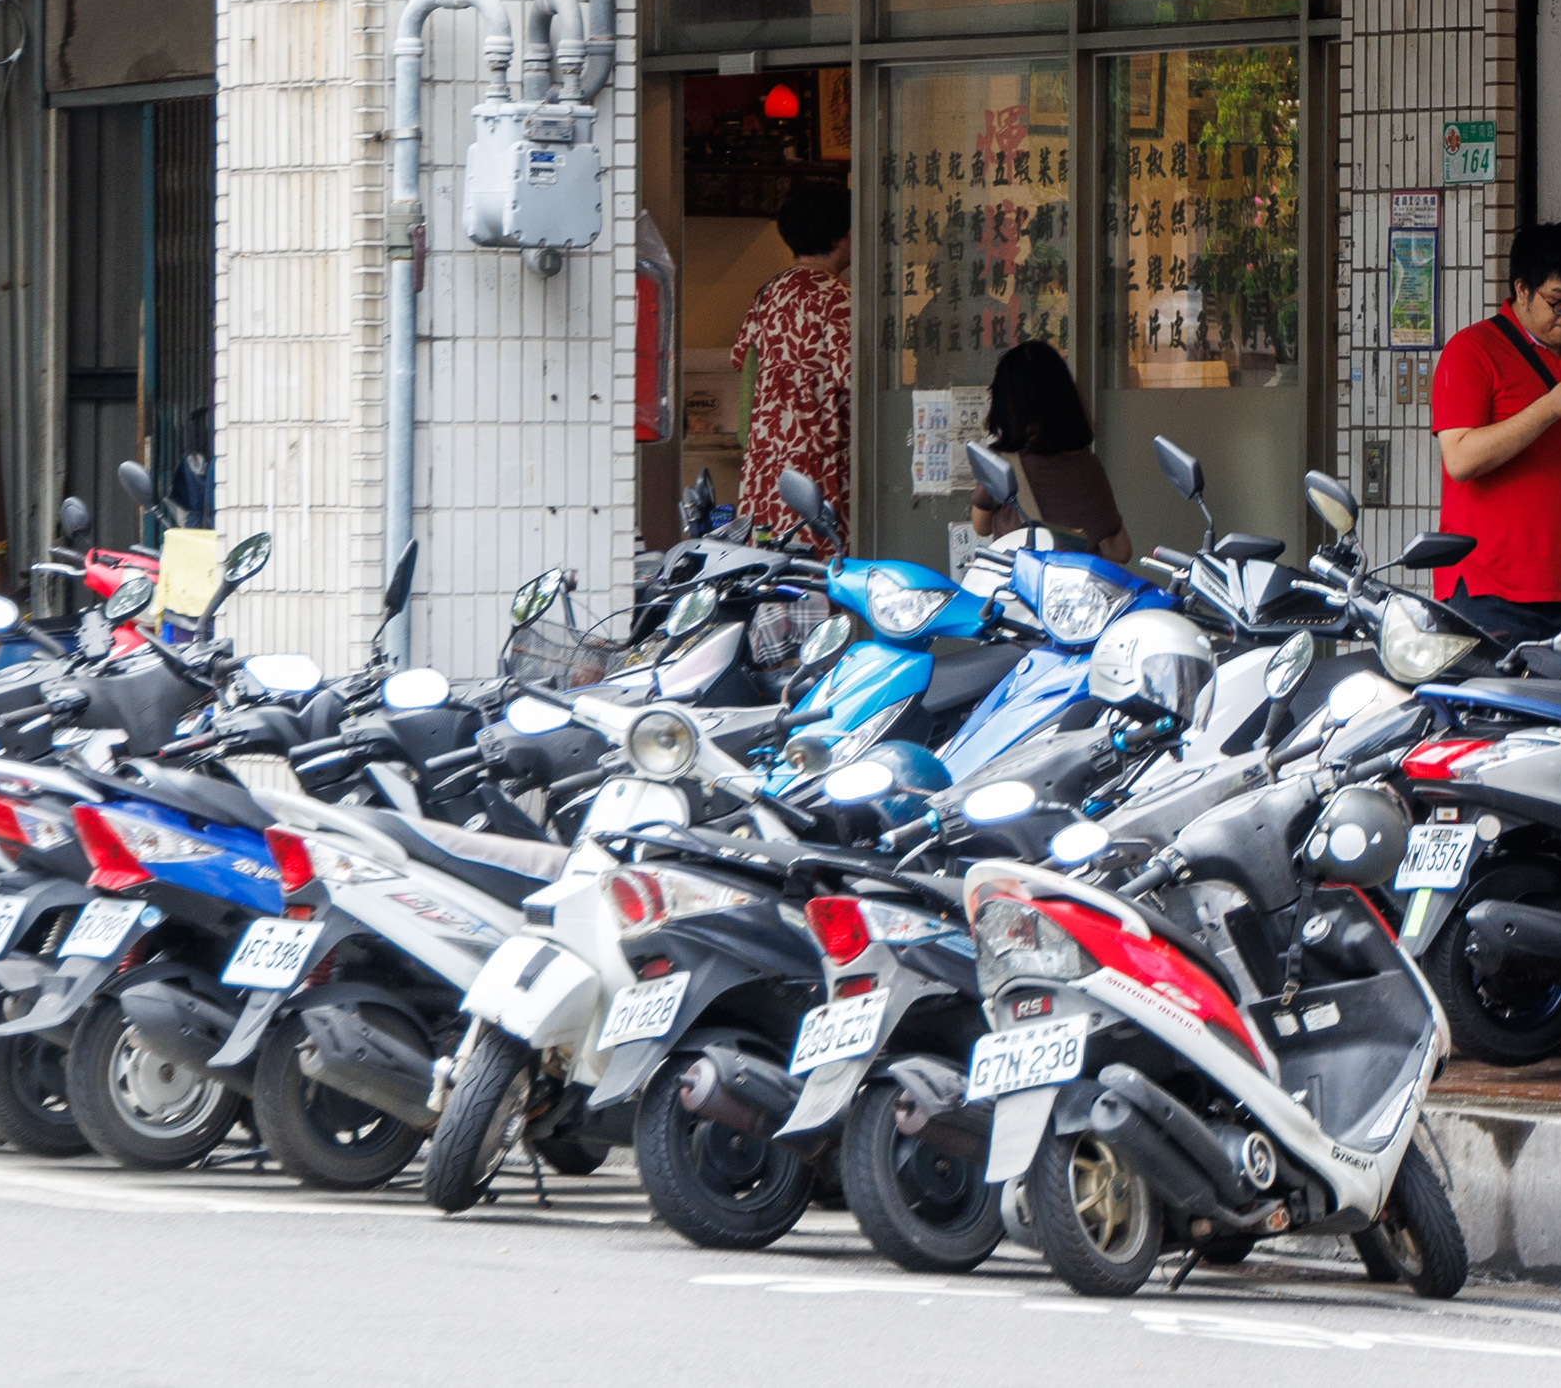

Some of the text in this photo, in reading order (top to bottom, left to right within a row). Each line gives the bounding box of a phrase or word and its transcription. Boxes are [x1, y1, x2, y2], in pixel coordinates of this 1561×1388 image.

[1462, 149, 1490, 174] 164
[236, 938, 308, 972] AFC-3986
[1017, 996, 1045, 1018] RS
[1106, 976, 1202, 1036] MOTOGP REPLICA
[974, 1038, 1079, 1088] G7N-238
